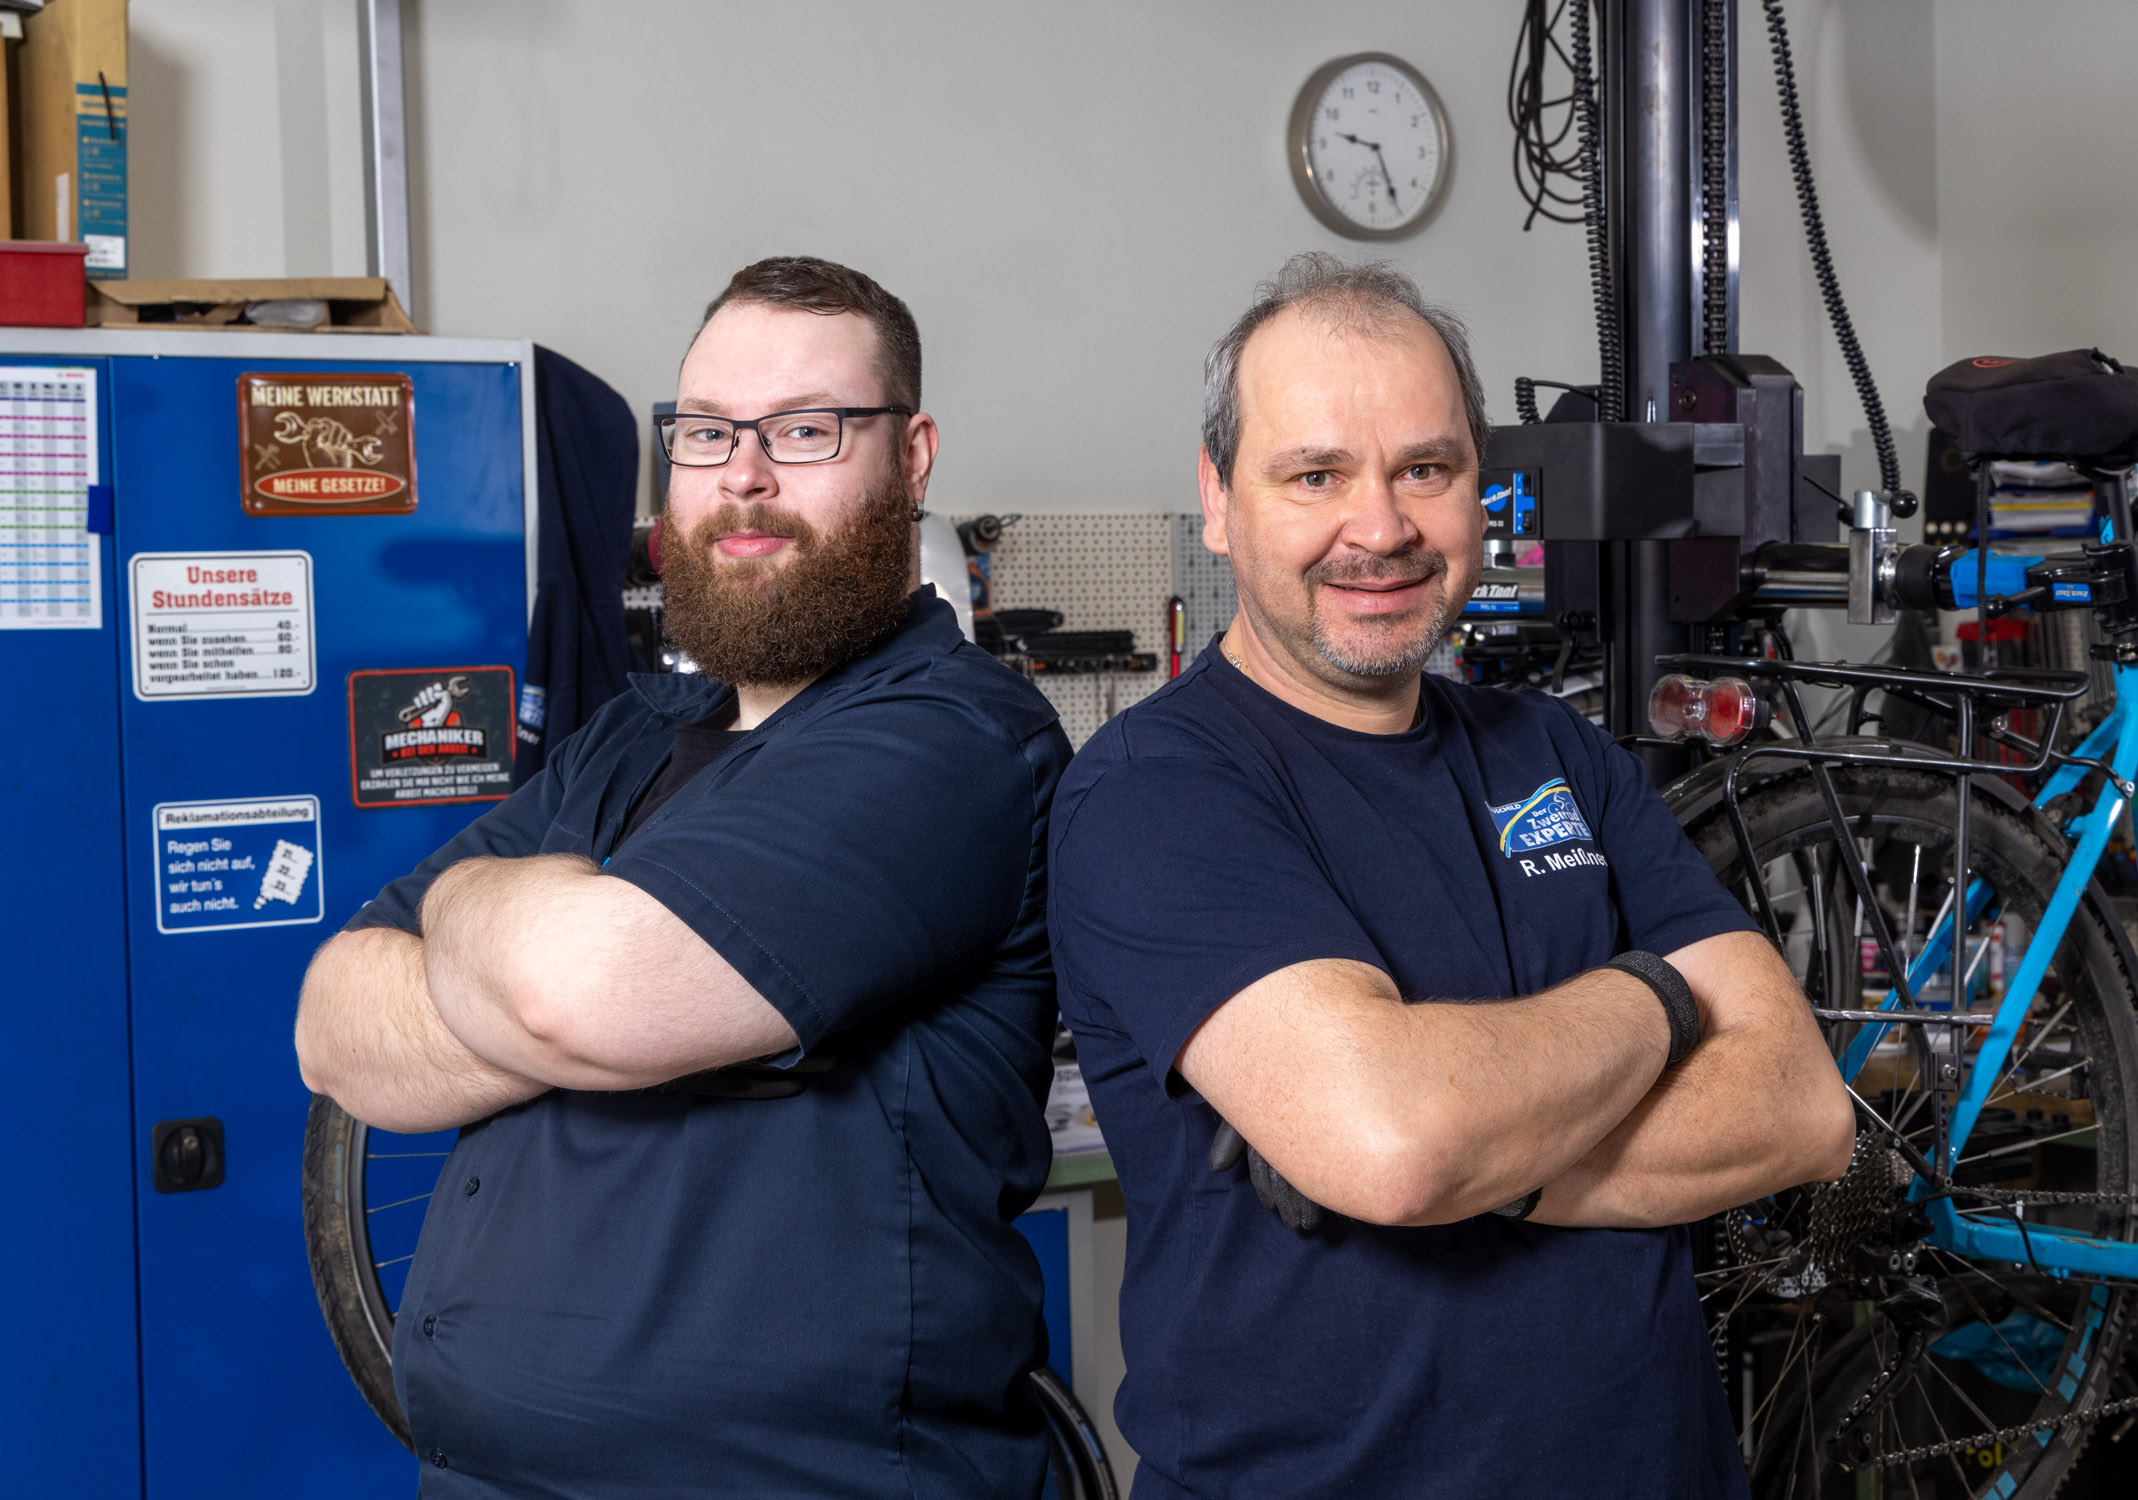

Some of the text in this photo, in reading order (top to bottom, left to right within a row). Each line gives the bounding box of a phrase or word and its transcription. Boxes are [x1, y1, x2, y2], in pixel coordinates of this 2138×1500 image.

[252, 386, 400, 407] MEINE WERKSTATT
[273, 477, 386, 494] MEINE GESETZE!
[187, 566, 257, 584] Unsere
[152, 588, 293, 609] Stundensätze
[148, 624, 187, 633] Normal
[148, 638, 177, 646] wenn
[181, 635, 198, 645] Sie
[149, 650, 177, 658] wenn
[181, 648, 198, 657] Sie
[149, 662, 178, 670] wenn
[181, 660, 198, 669] Sie
[385, 730, 484, 750] MECHANIKER
[370, 768, 384, 779] UM
[485, 772, 510, 783] MEINE
[165, 808, 310, 824] Reklamationsabteilung
[1526, 808, 1581, 831] Zweirad
[1531, 808, 1547, 818] Der
[1519, 821, 1590, 847] EXPERTE
[167, 838, 232, 856] Regen Sie
[168, 855, 256, 874] sich nicht auf,
[1519, 847, 1609, 878] R. Meißner
[168, 880, 189, 894] wir
[169, 897, 239, 914] auch nicht.
